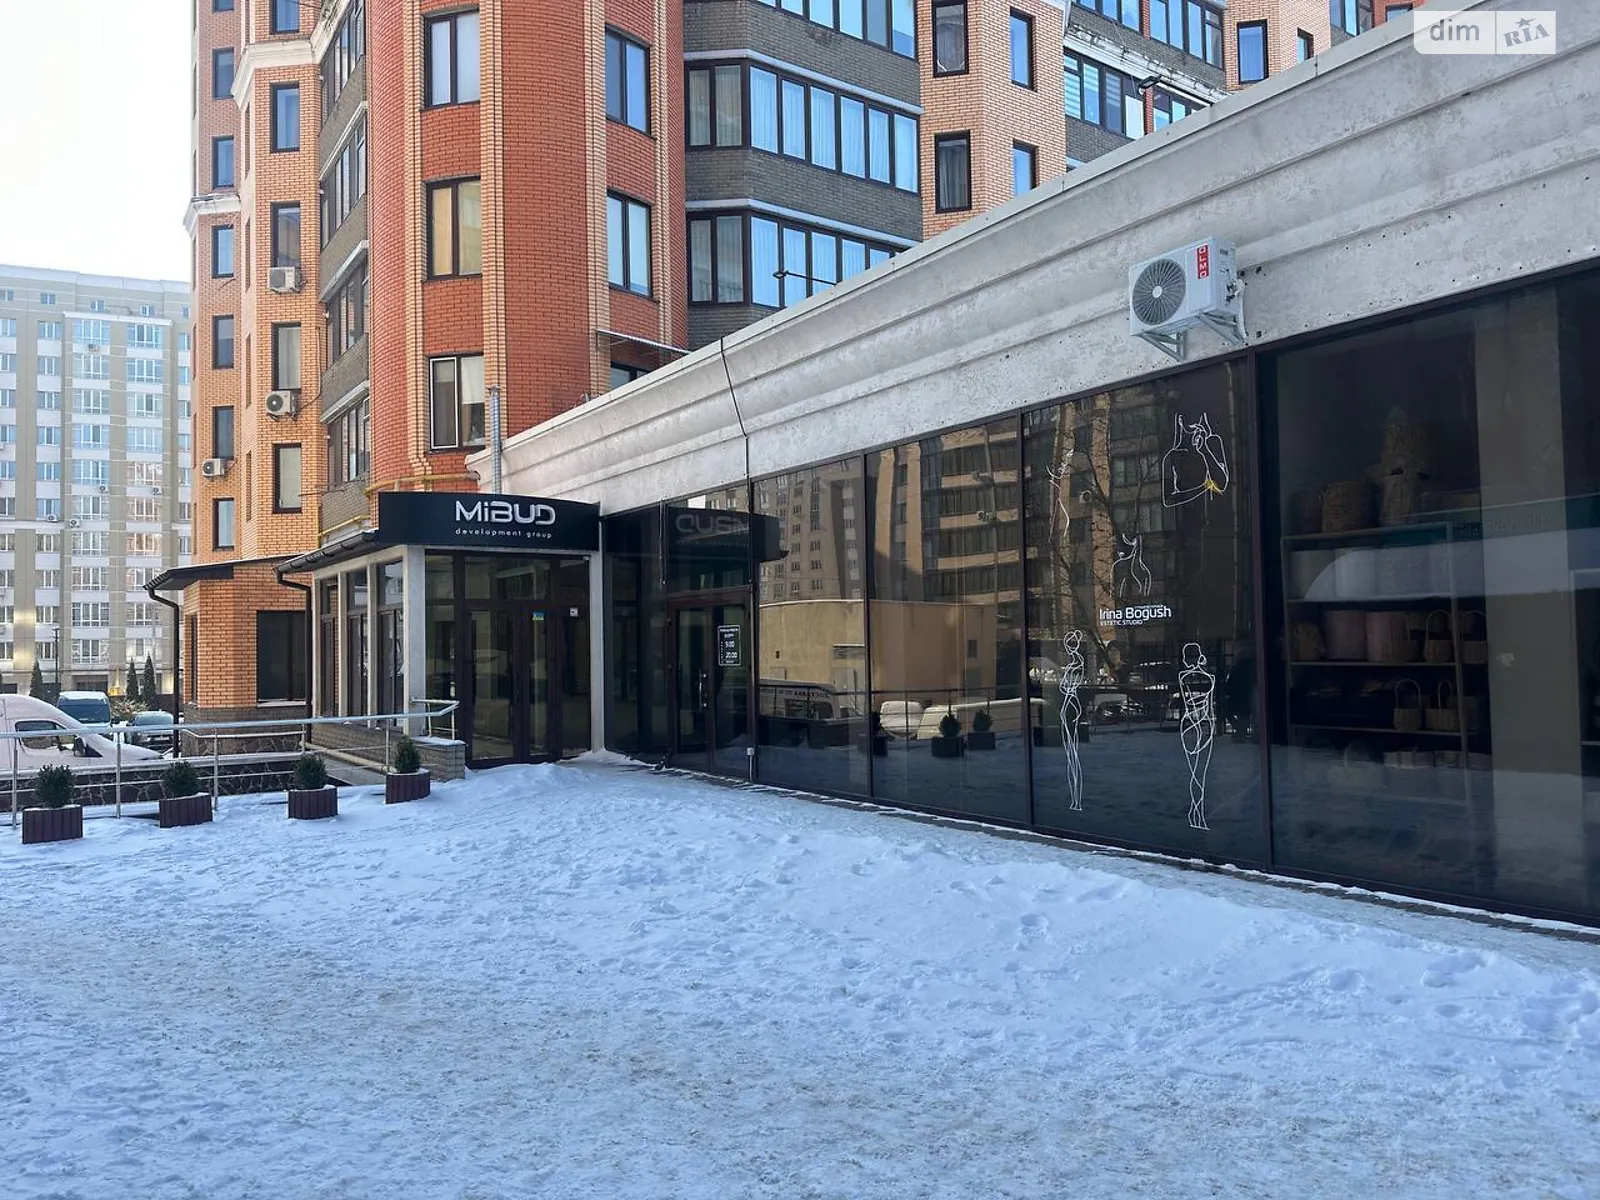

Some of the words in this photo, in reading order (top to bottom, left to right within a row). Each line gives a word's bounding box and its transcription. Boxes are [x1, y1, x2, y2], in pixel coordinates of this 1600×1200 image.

[455, 500, 556, 525] MiBUD
[455, 528, 521, 537] development
[1100, 608, 1123, 620] Irina
[1125, 606, 1172, 620] Bogush
